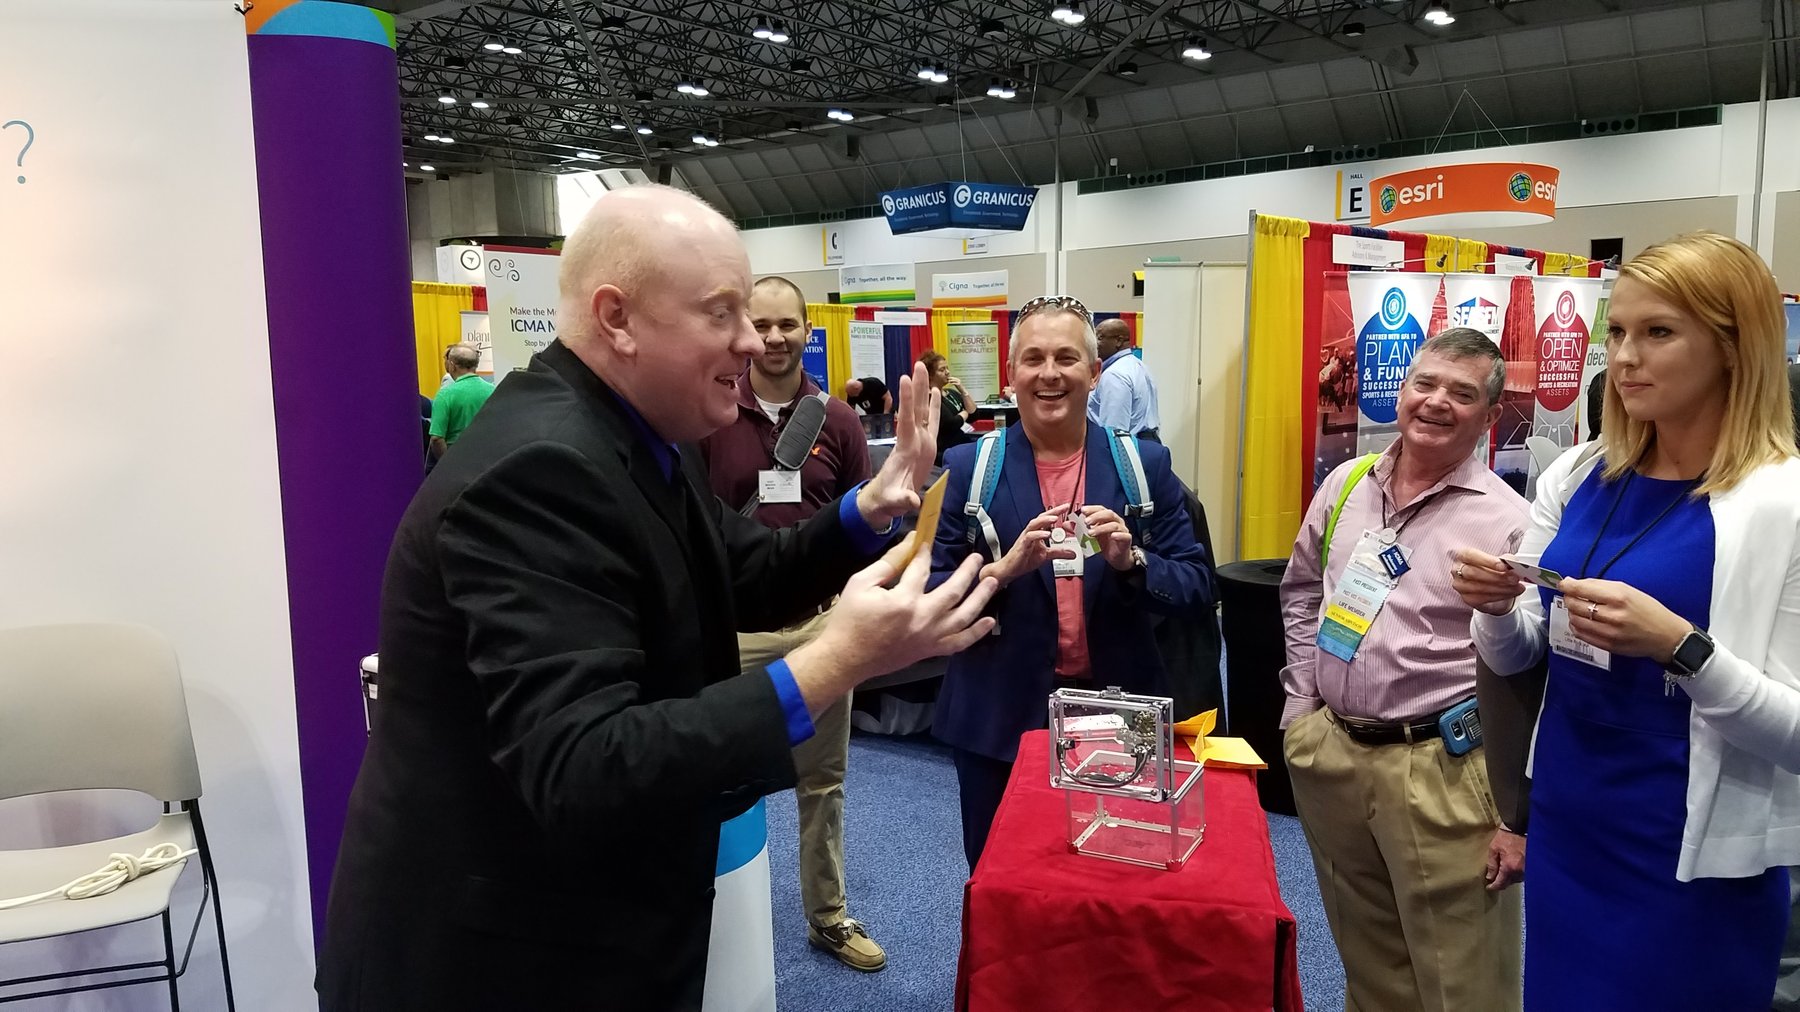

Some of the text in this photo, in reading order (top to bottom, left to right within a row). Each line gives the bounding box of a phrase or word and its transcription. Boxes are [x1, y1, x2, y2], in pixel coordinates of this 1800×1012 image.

[2, 120, 34, 184] ?
[1399, 174, 1444, 204] esri
[896, 190, 946, 210] GRANICUS
[973, 191, 1034, 206] GRANICUS
[1350, 187, 1363, 212] E
[948, 282, 969, 290] Cigna
[510, 306, 531, 316] Make
[533, 308, 545, 316] the
[511, 319, 546, 333] ICMA
[853, 326, 882, 335] POWERFUL
[1364, 341, 1416, 366] PLAN
[1542, 338, 1582, 358] OPEN
[1540, 360, 1580, 372] & OPTIMIZE
[1363, 368, 1372, 380] &
[1539, 373, 1578, 381] SUCCESSFUL
[1362, 391, 1380, 399] SPORTS
[1348, 605, 1366, 617] MEMBER
